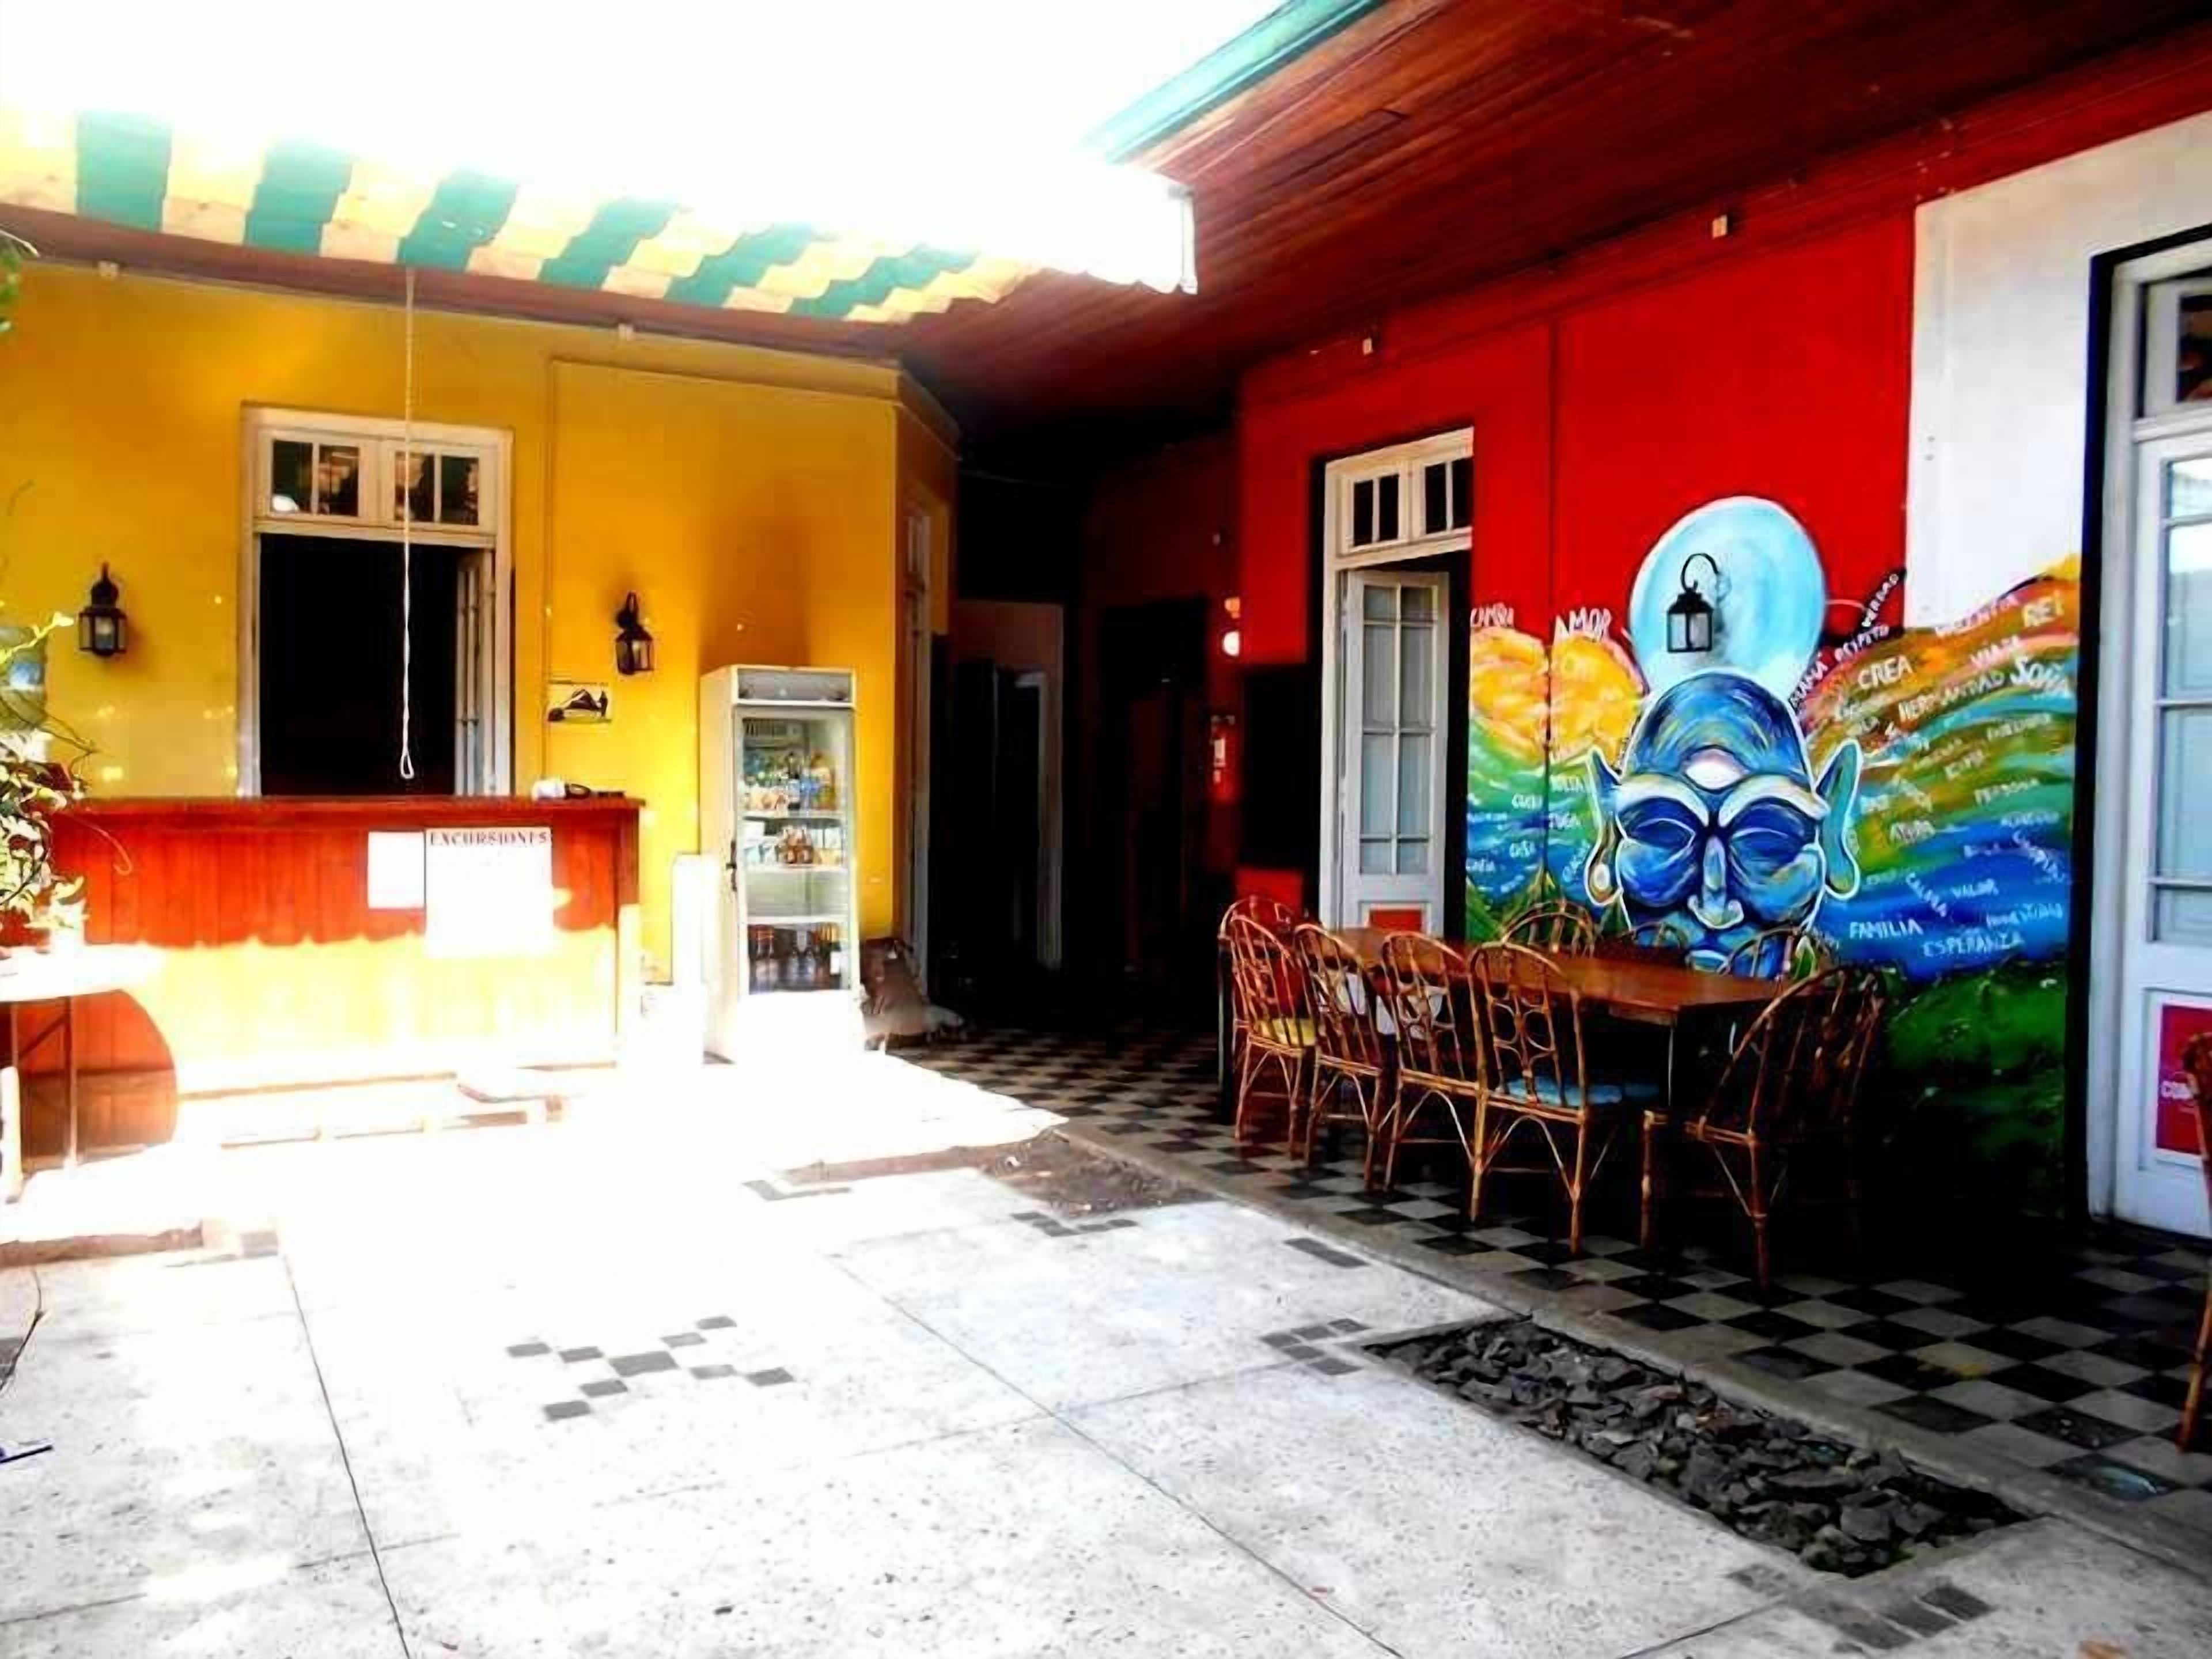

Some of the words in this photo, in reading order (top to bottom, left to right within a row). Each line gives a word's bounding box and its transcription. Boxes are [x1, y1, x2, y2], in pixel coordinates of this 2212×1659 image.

[1554, 607, 1612, 643] AMOR
[1857, 655, 1914, 690] CREA
[1849, 918, 1924, 940] FAMILIA
[1922, 928, 2025, 958] ESPERANZA
